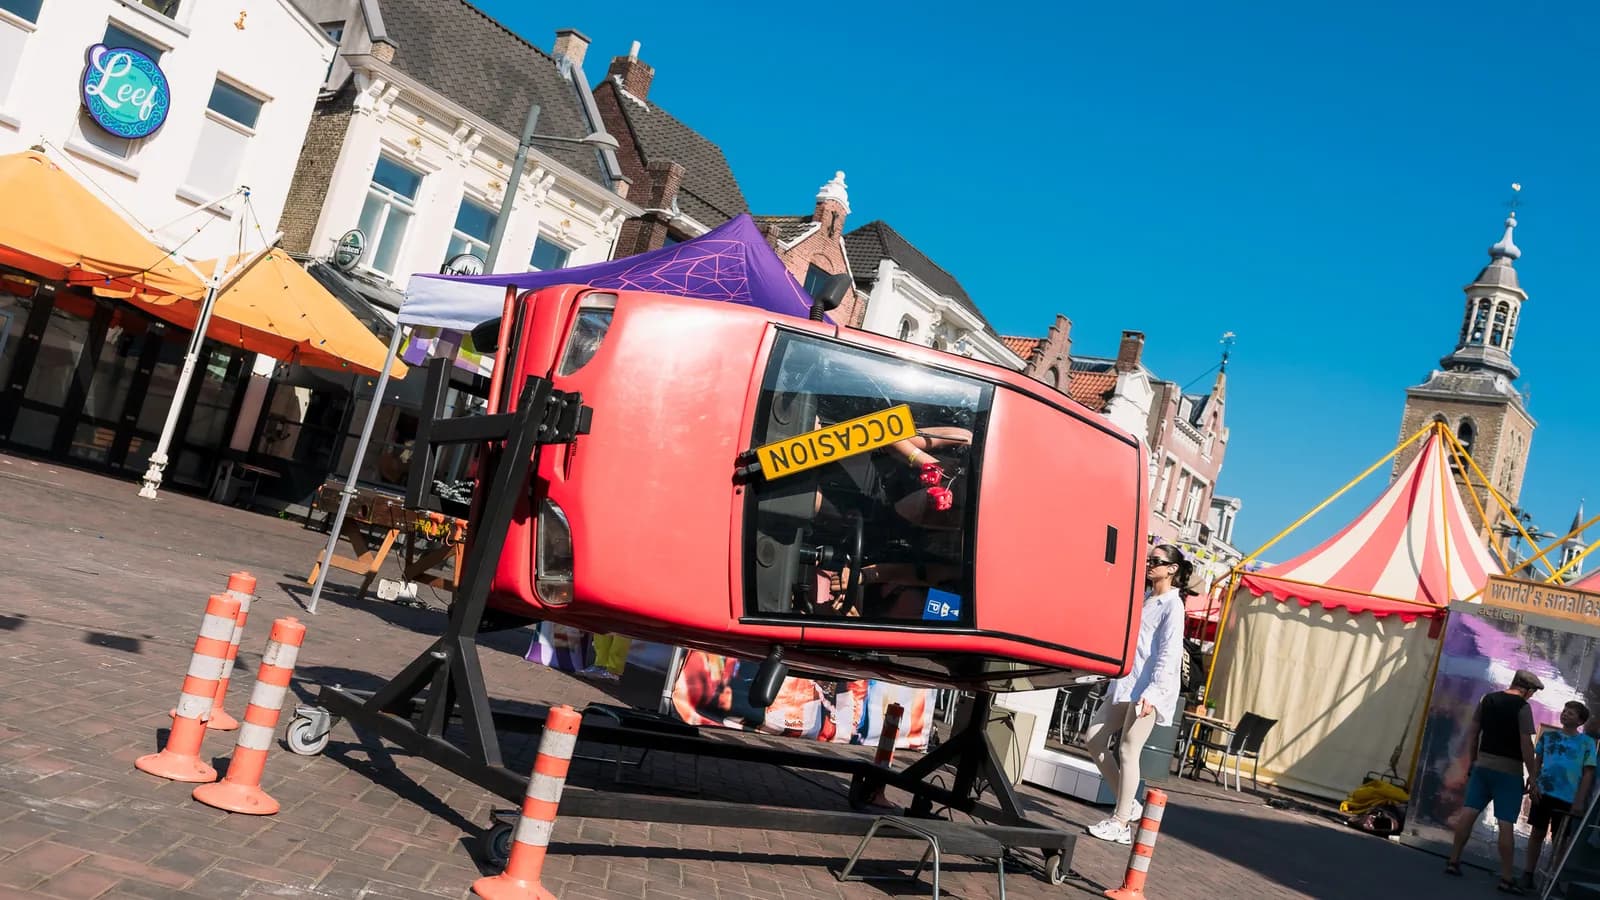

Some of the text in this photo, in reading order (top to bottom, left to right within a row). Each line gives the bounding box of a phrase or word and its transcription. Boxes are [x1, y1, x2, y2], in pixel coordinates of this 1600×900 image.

[85, 46, 158, 121] Leef
[770, 414, 904, 472] OCCASION
[1491, 583, 1542, 606] world's
